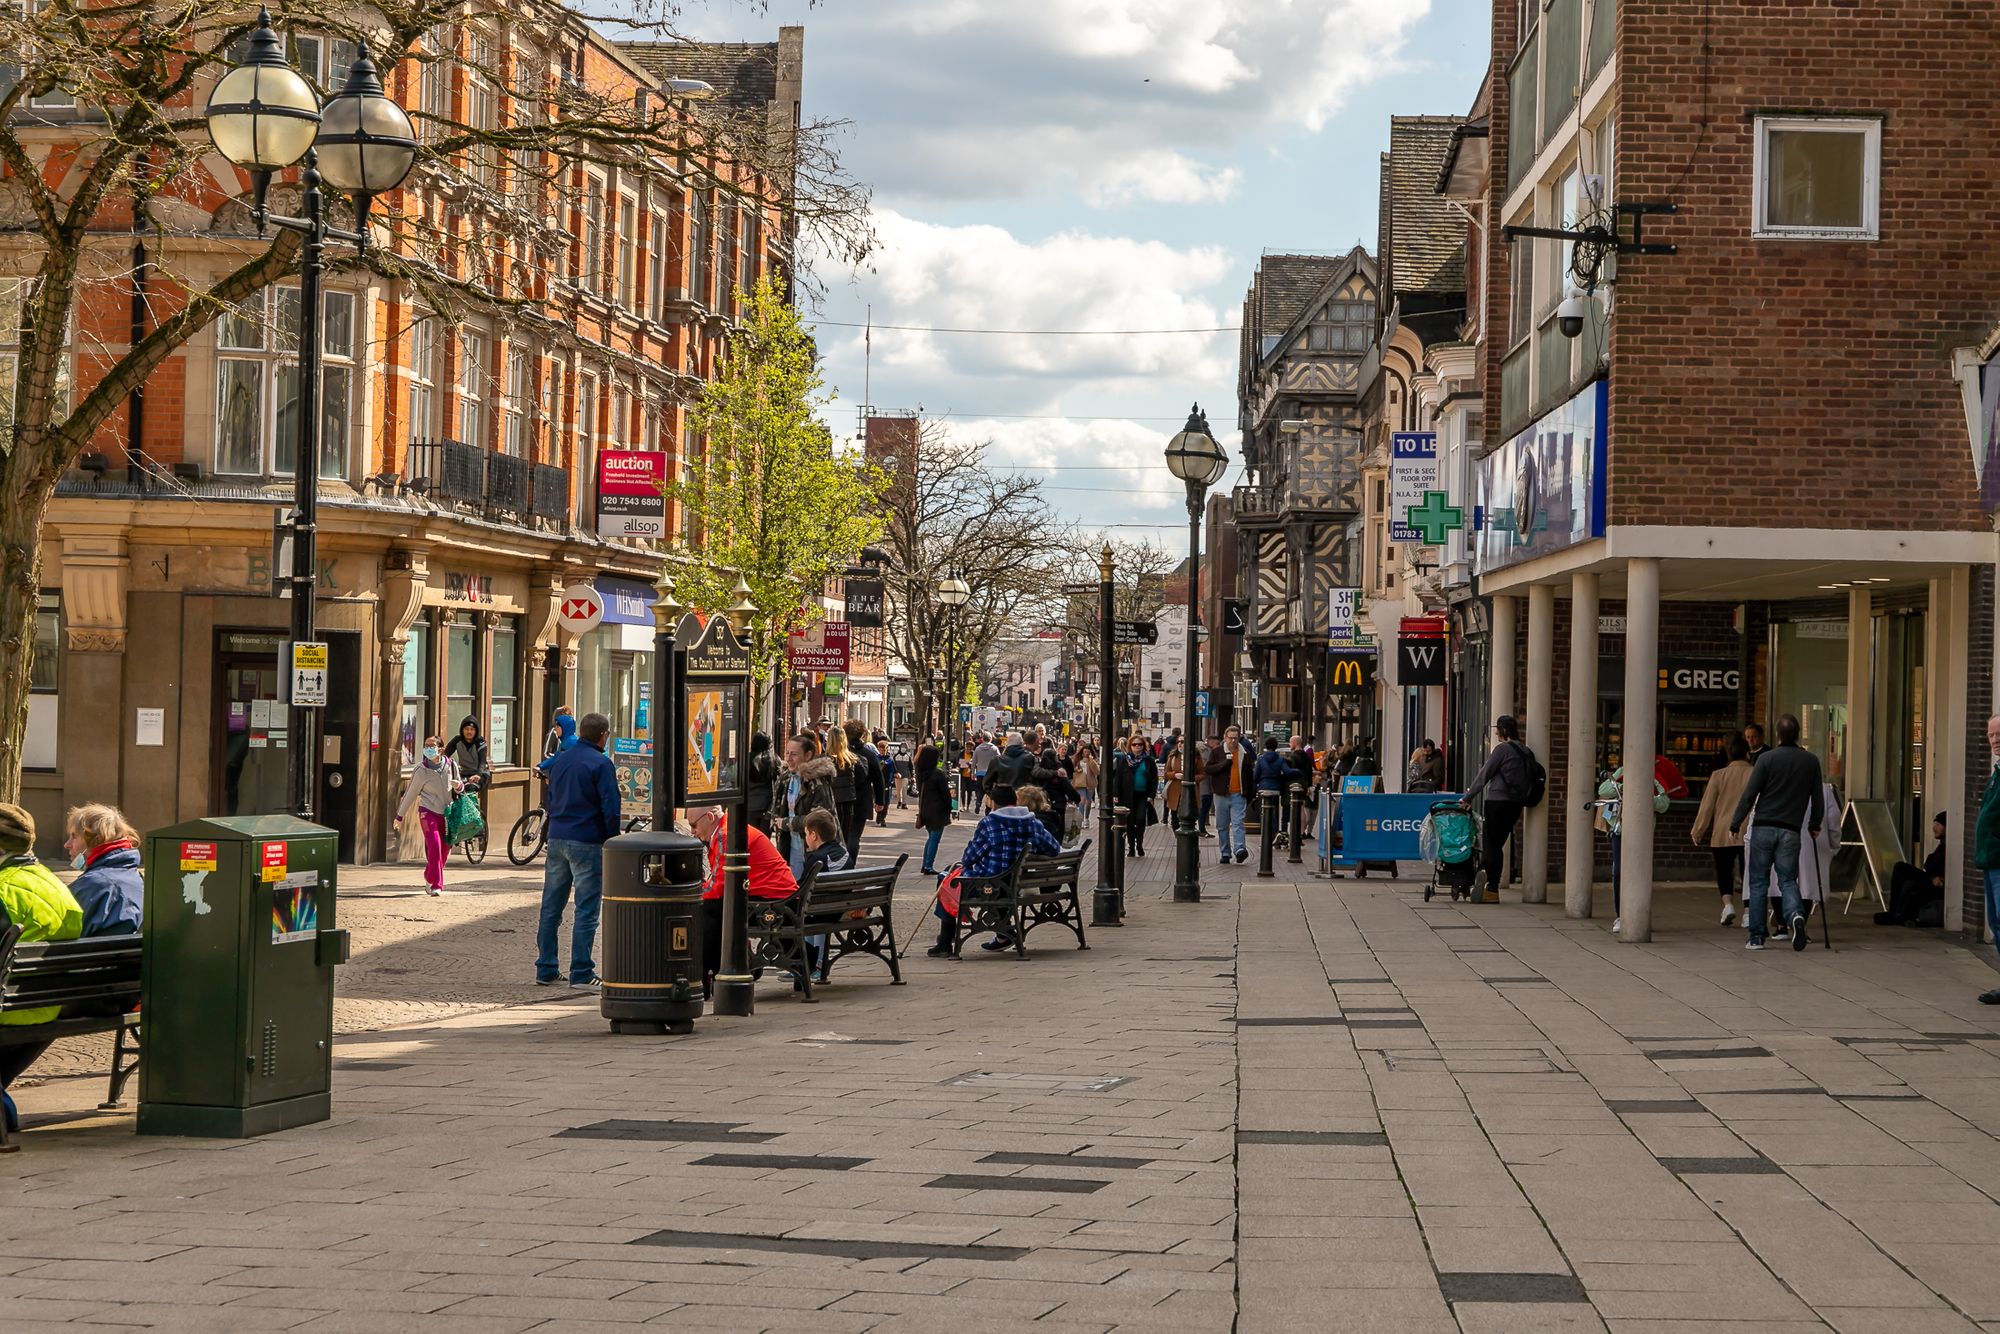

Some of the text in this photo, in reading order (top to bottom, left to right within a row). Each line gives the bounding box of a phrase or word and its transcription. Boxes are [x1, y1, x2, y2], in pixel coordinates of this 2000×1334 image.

[1397, 439, 1416, 452] TO
[606, 457, 652, 470] auction
[602, 496, 661, 506] 020 7543 6800
[624, 519, 659, 534] allsop
[248, 556, 337, 588] BK
[616, 588, 645, 618] WHSmith
[848, 603, 880, 612] BEAR
[1335, 606, 1350, 618] TO
[1332, 629, 1353, 638] perki
[230, 636, 260, 644] Welcome
[707, 645, 730, 655] Welcome to
[690, 657, 746, 670] The County Town of Stafford
[807, 657, 825, 665] 7526
[827, 658, 844, 666] 2010
[1406, 646, 1438, 669] W
[1346, 786, 1368, 794] DEALS
